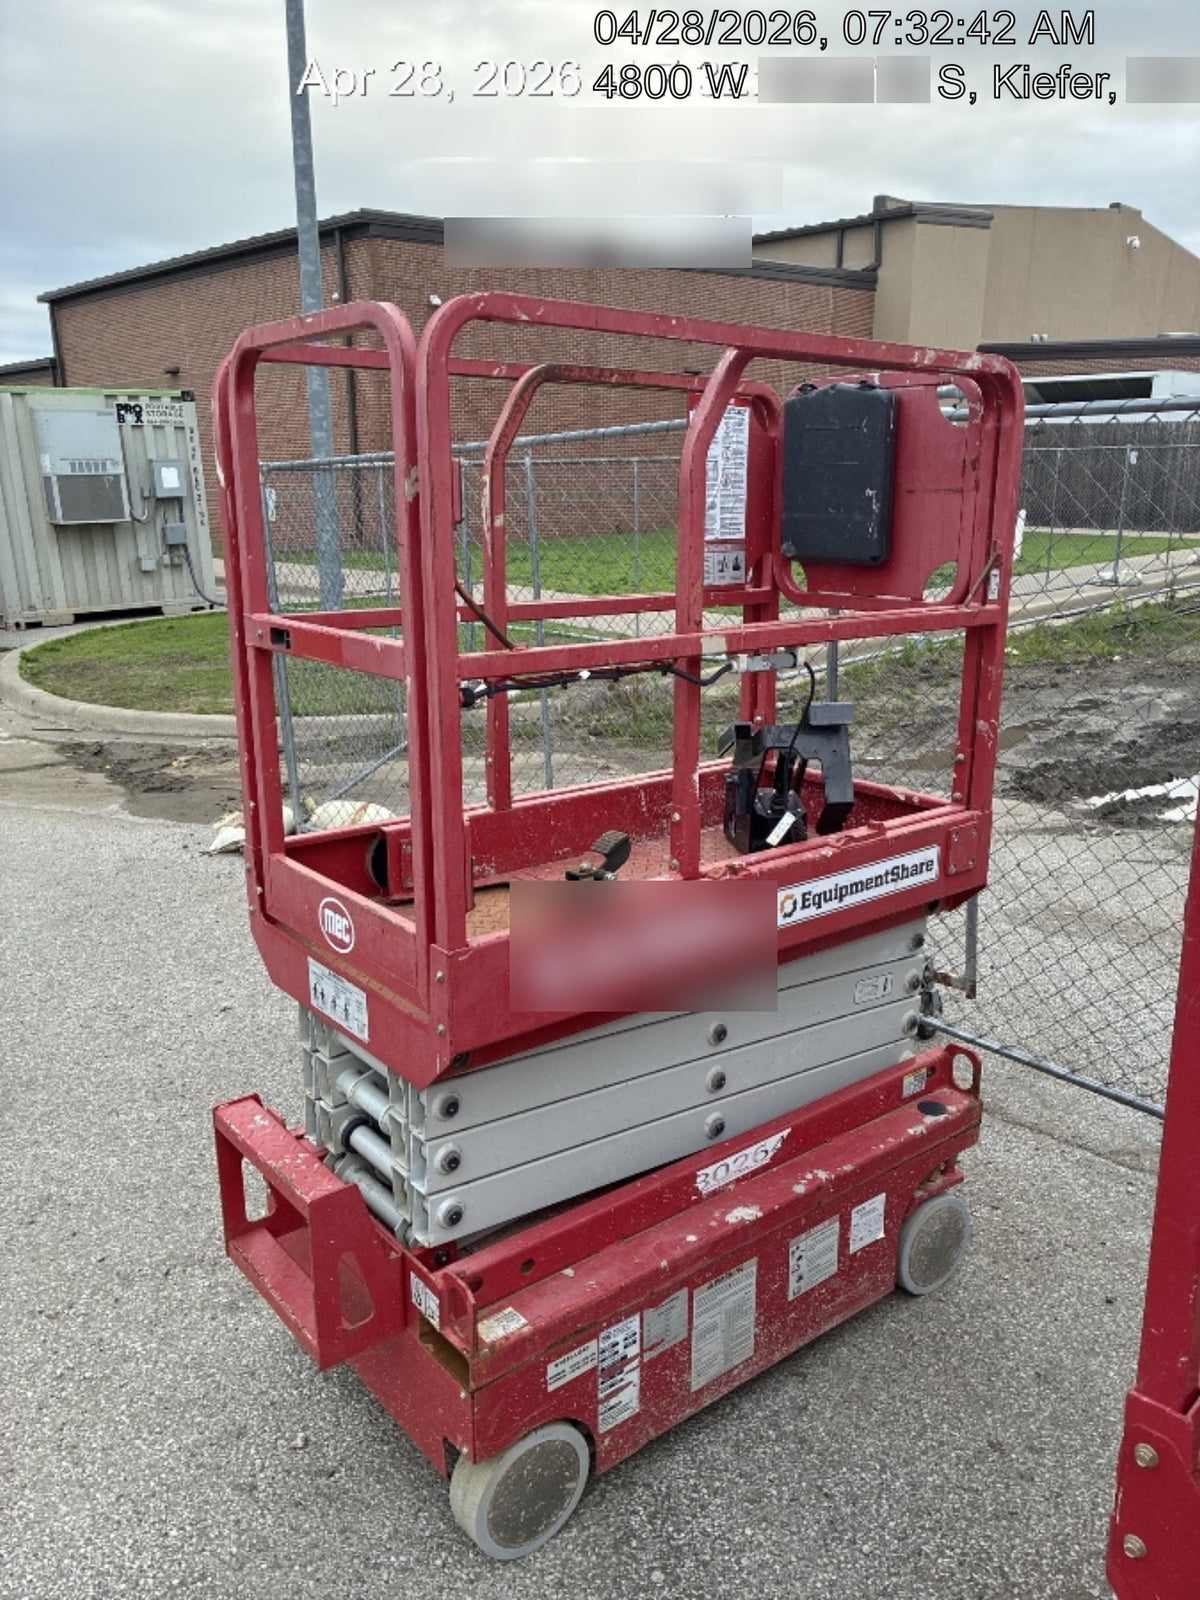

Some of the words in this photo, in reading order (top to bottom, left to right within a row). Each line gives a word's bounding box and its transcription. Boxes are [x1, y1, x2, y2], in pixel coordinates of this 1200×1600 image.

[116, 403, 143, 414] PRO
[117, 412, 144, 424] BX
[800, 859, 935, 911] EquipmentShare
